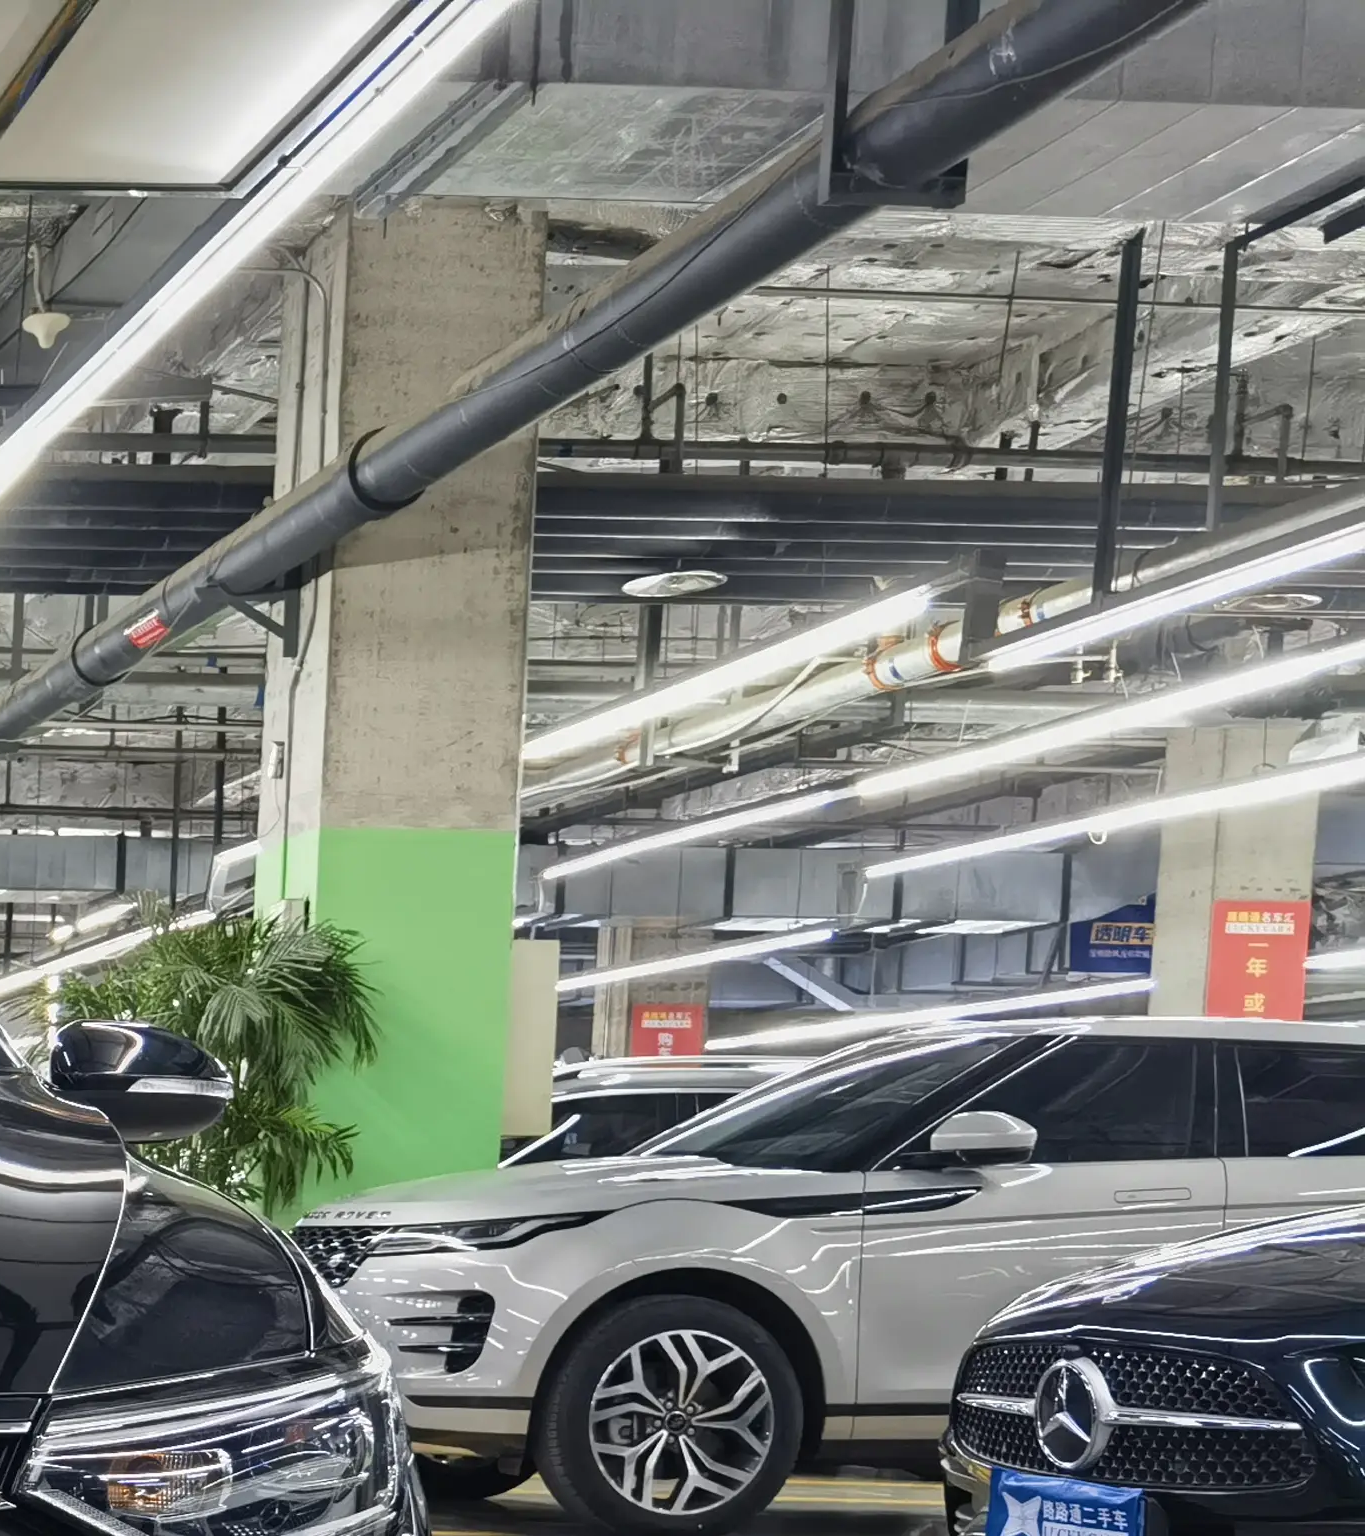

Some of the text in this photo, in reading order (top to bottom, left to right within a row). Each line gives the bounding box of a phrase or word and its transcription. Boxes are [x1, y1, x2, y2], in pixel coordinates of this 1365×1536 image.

[1043, 1500, 1129, 1530] 路路通二手车
